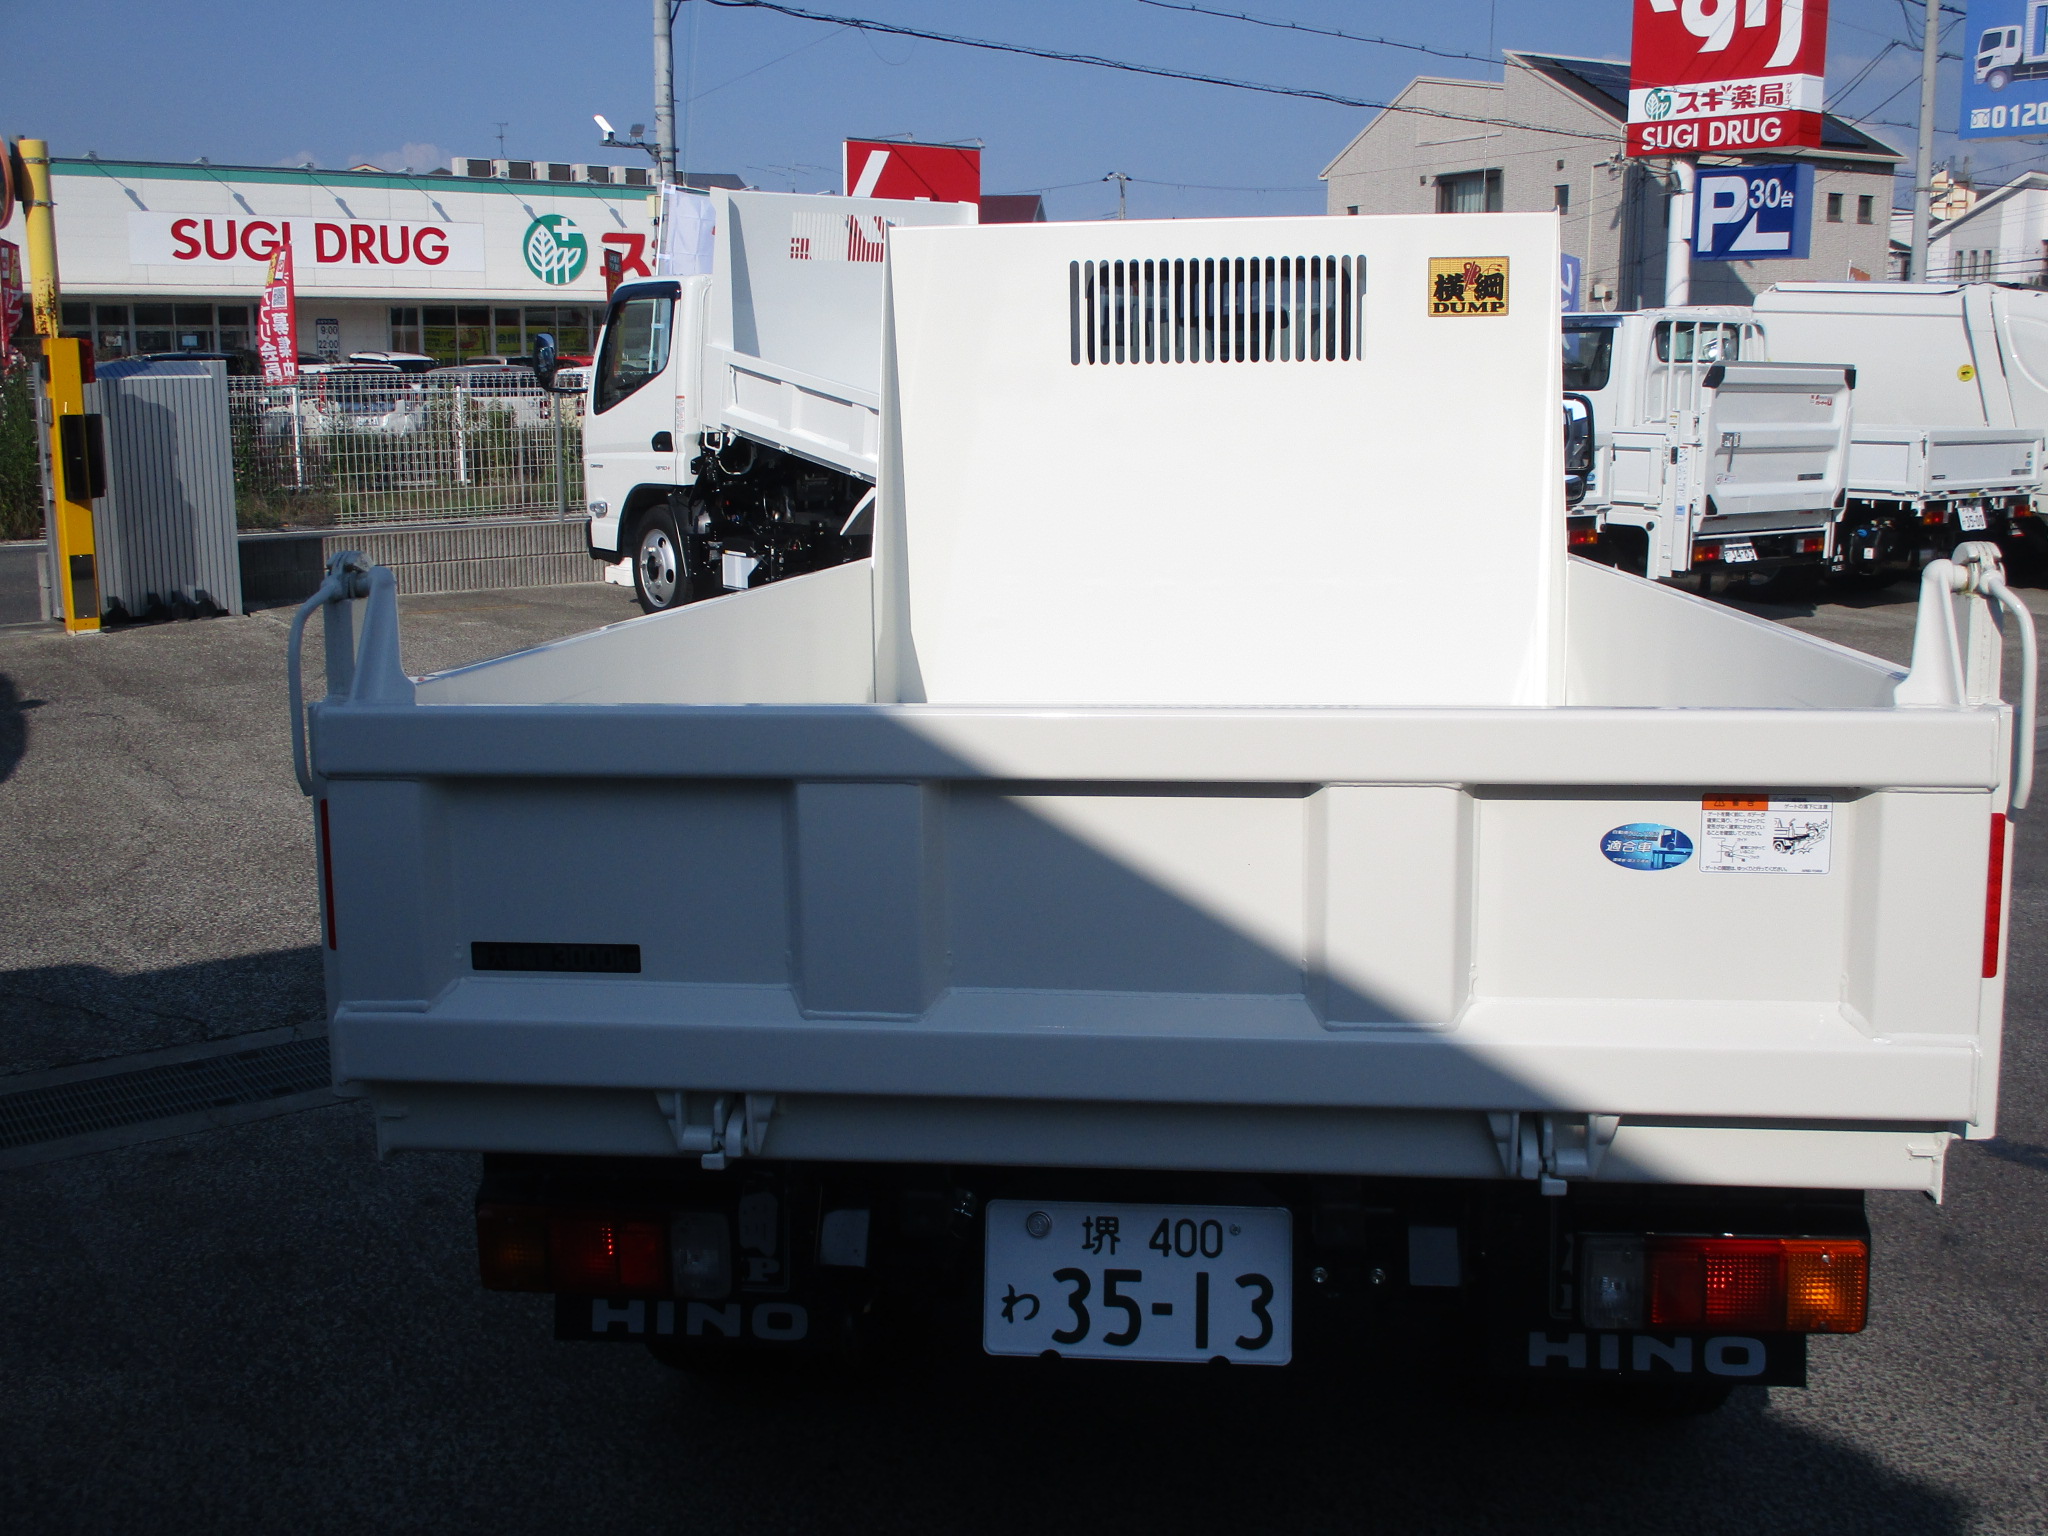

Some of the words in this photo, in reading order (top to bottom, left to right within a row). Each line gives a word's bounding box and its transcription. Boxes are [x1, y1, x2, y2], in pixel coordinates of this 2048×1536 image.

[1676, 82, 1784, 114] スギ薬局
[1641, 122, 1699, 151] SUGI
[1708, 117, 1782, 146] DRUG
[1697, 176, 1748, 252] P
[1749, 178, 1794, 209] 30台
[170, 218, 291, 262] SUGI
[314, 222, 450, 266] DRUG
[1432, 301, 1505, 313] DUMP
[318, 340, 339, 349] 22:00
[320, 325, 338, 335] 9:00
[1605, 839, 1653, 853] 適合車
[1081, 1215, 1122, 1256] 堺
[1149, 1217, 1224, 1259] 400
[590, 1298, 809, 1342] HINO
[1000, 1283, 1040, 1324] わ
[1051, 1266, 1275, 1351] 35-13
[1528, 1330, 1767, 1377] HINO
